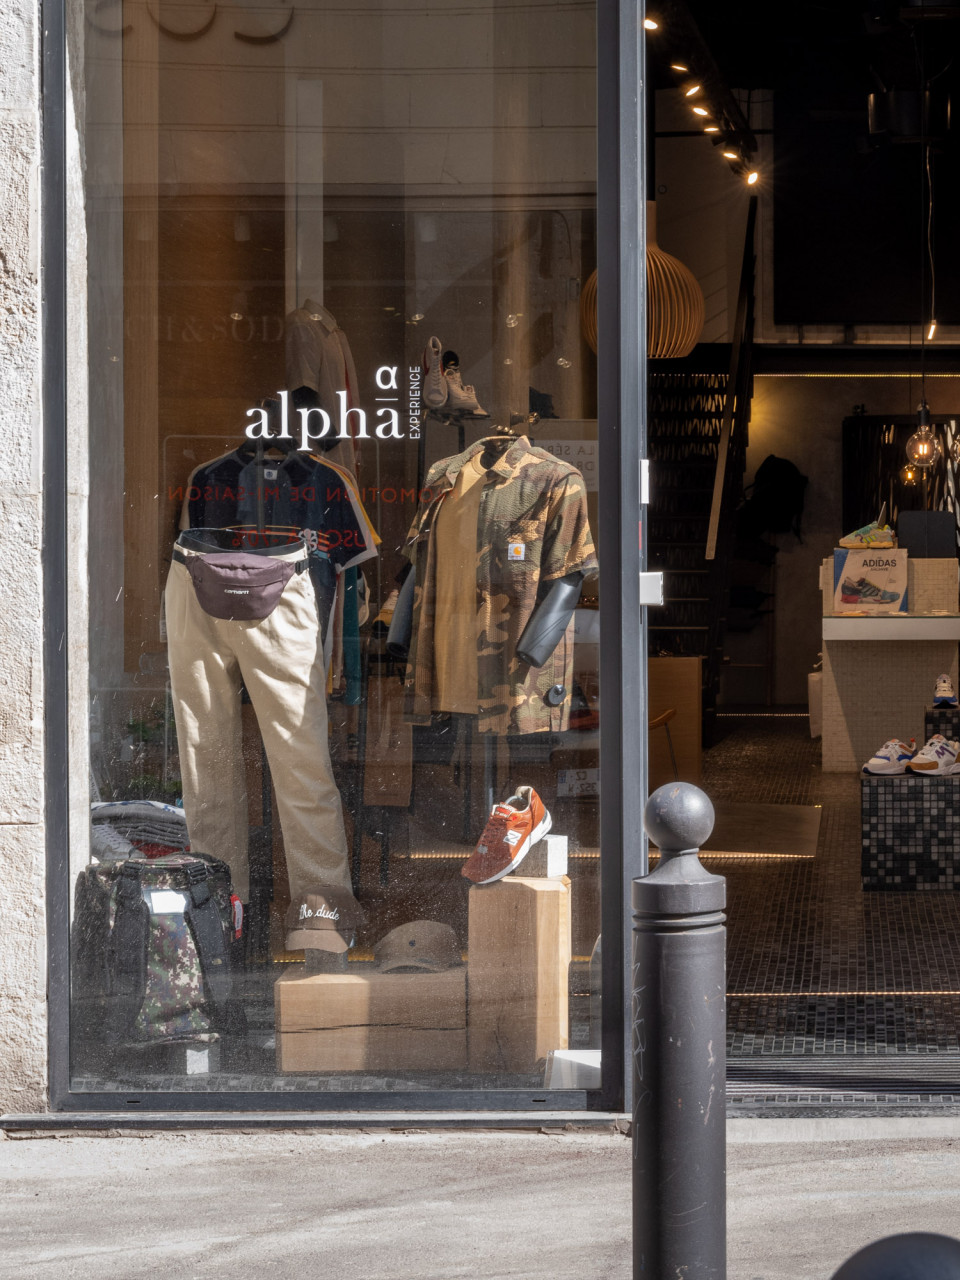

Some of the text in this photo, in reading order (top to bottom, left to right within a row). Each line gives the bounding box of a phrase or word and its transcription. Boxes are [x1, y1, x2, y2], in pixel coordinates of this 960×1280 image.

[245, 391, 405, 451] alpha
[409, 365, 421, 440] EXPERIENCE
[862, 559, 897, 567] ADIDAS
[313, 903, 340, 921] dude
